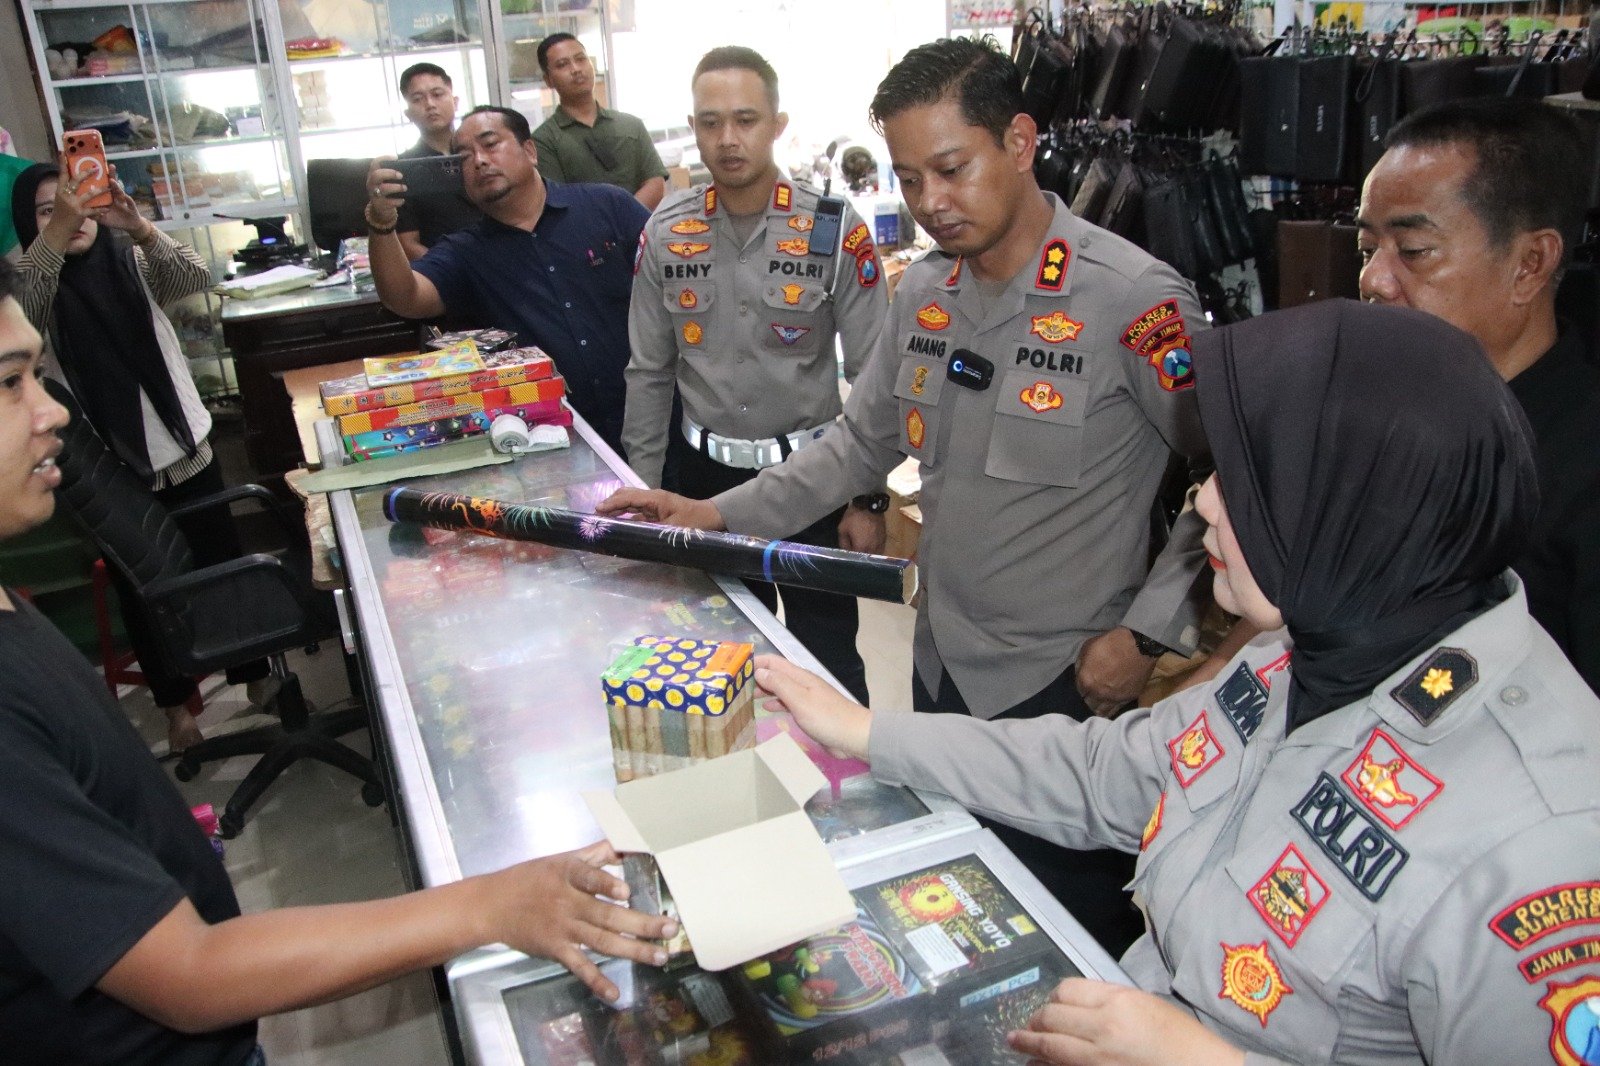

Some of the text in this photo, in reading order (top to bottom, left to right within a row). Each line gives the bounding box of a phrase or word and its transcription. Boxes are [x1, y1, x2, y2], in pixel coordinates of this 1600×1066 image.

[665, 263, 712, 278] BENY
[769, 260, 824, 278] POLRI
[1128, 305, 1167, 337] POLRES
[1130, 310, 1173, 345] SUMENEP
[907, 335, 947, 358] ANANG
[1141, 322, 1181, 353] JAWA TIMUR
[1016, 347, 1083, 374] POLRI
[1299, 782, 1396, 888] POLRI
[939, 873, 984, 917] GANSING
[979, 917, 1012, 948] YOYO
[1515, 887, 1600, 928] POLRES
[1533, 947, 1576, 974] JAWA
